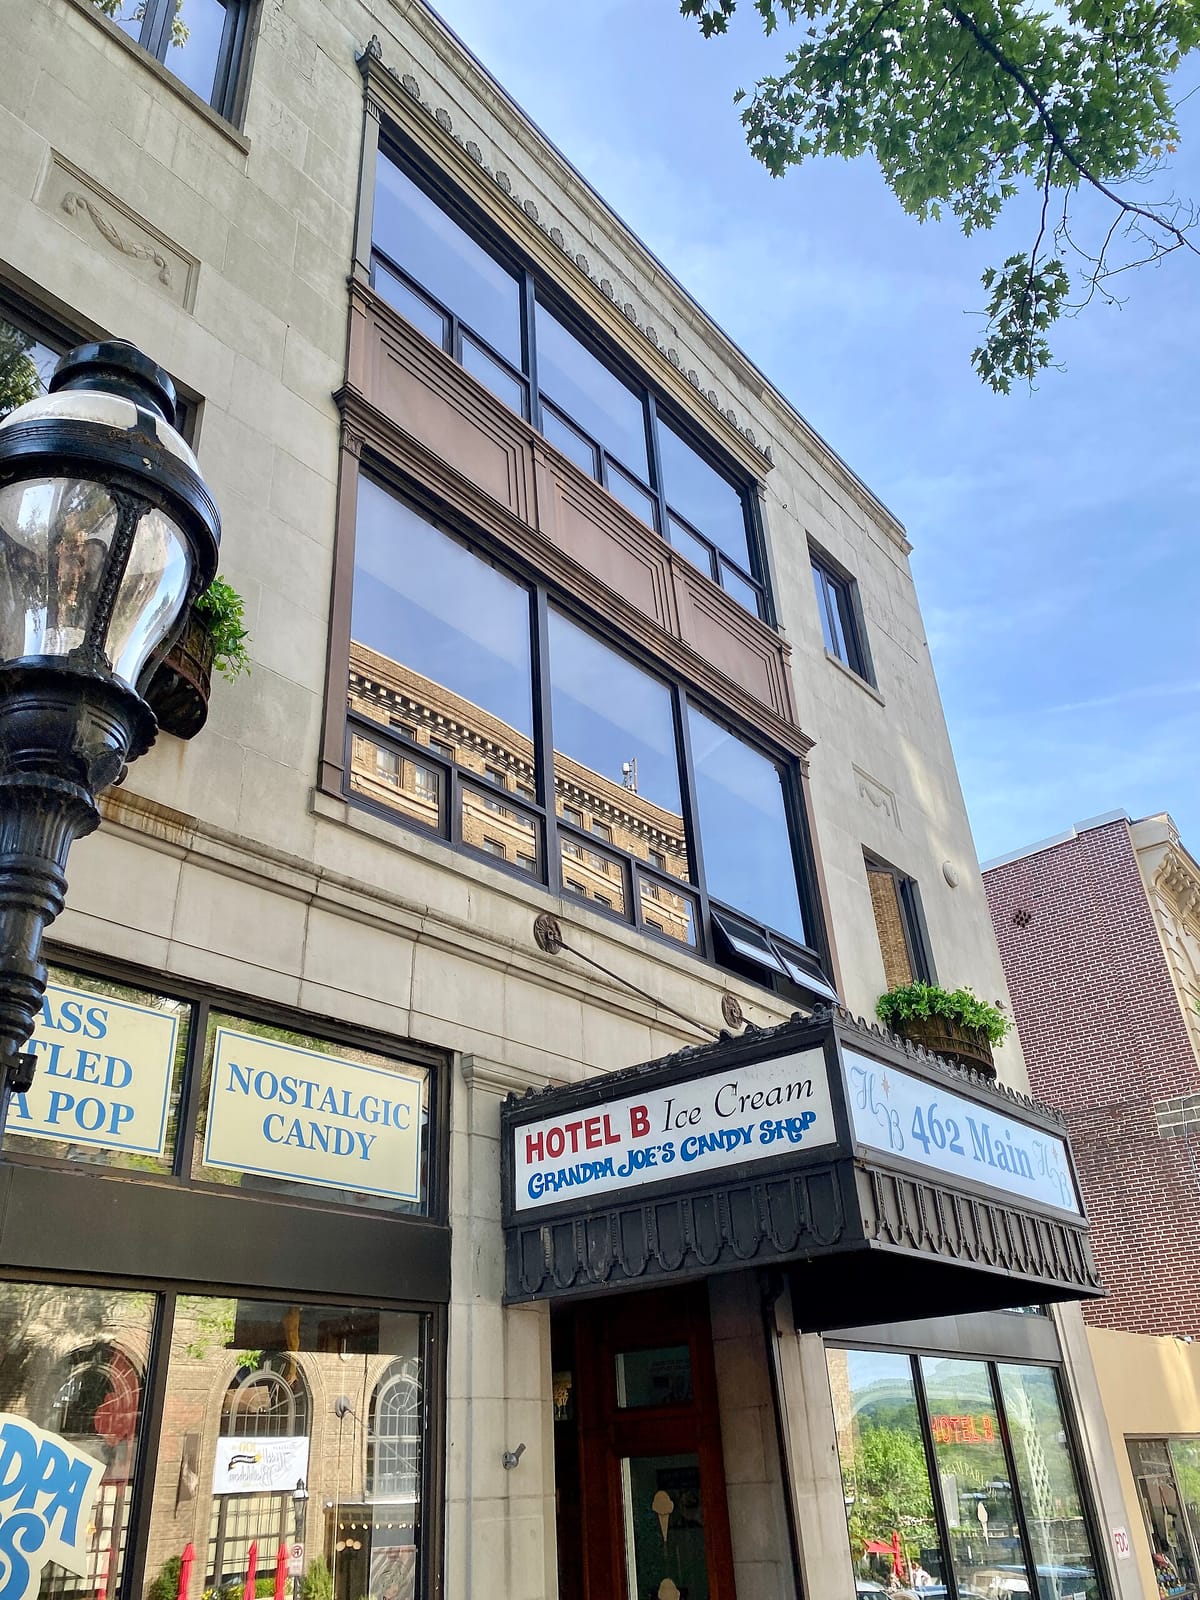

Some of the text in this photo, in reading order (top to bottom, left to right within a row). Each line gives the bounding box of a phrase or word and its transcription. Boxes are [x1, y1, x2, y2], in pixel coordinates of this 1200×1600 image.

[44, 1090, 134, 1135] POP
[226, 1062, 411, 1130] NOSTALGIC
[661, 1078, 814, 1133] Ice Cream
[262, 1113, 377, 1161] CANDY
[526, 1104, 651, 1164] HOTEL B
[527, 1110, 817, 1199] GRANDPA JOE'S CANDY SHOP
[911, 1103, 1036, 1181] 462 Main
[981, 1414, 995, 1443] B
